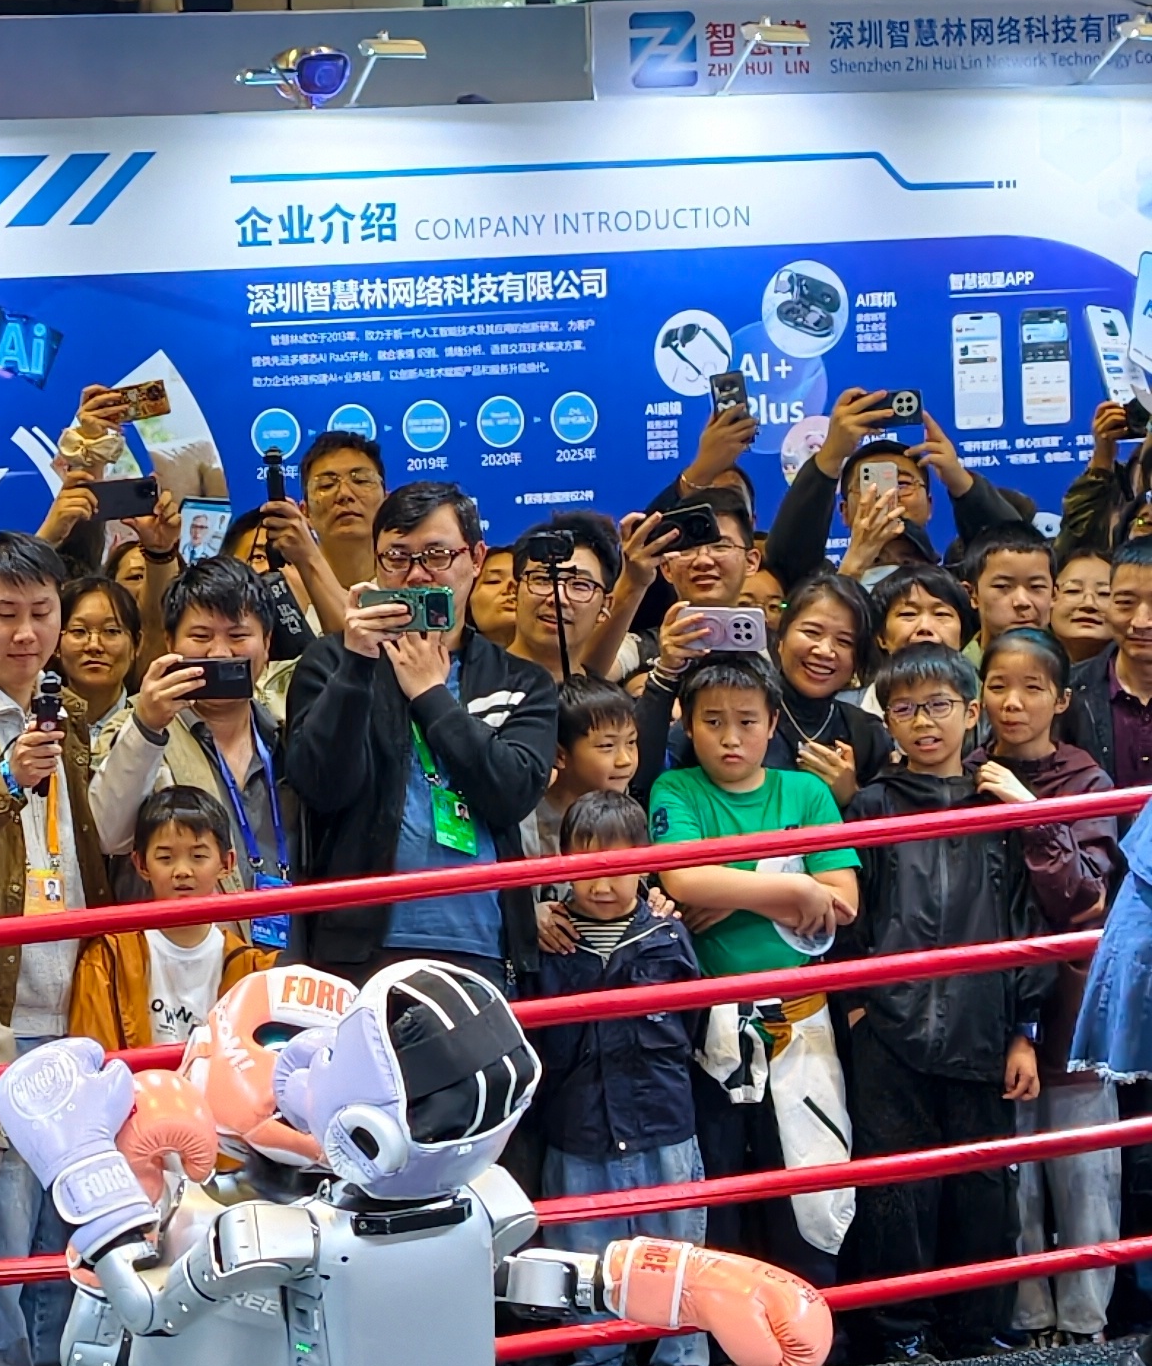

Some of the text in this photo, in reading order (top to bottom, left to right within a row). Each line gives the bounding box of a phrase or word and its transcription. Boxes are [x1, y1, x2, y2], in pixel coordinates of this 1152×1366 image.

[829, 13, 1152, 50] 深圳智慧林网络科技有限
[745, 62, 773, 76] HUI
[784, 60, 810, 74] LIN
[830, 58, 902, 74] Shenzhen
[905, 55, 928, 72] Zhi
[235, 202, 397, 248] 企业介绍
[415, 205, 750, 241] COMPANY INTRODUCTION
[247, 268, 608, 315] 深圳智慧林网络科技有限公司
[406, 456, 449, 472] 2019年
[481, 452, 522, 467] 2020年
[556, 448, 597, 463] 2025年
[281, 975, 356, 1017] FORC
[80, 1163, 134, 1200] FORC
